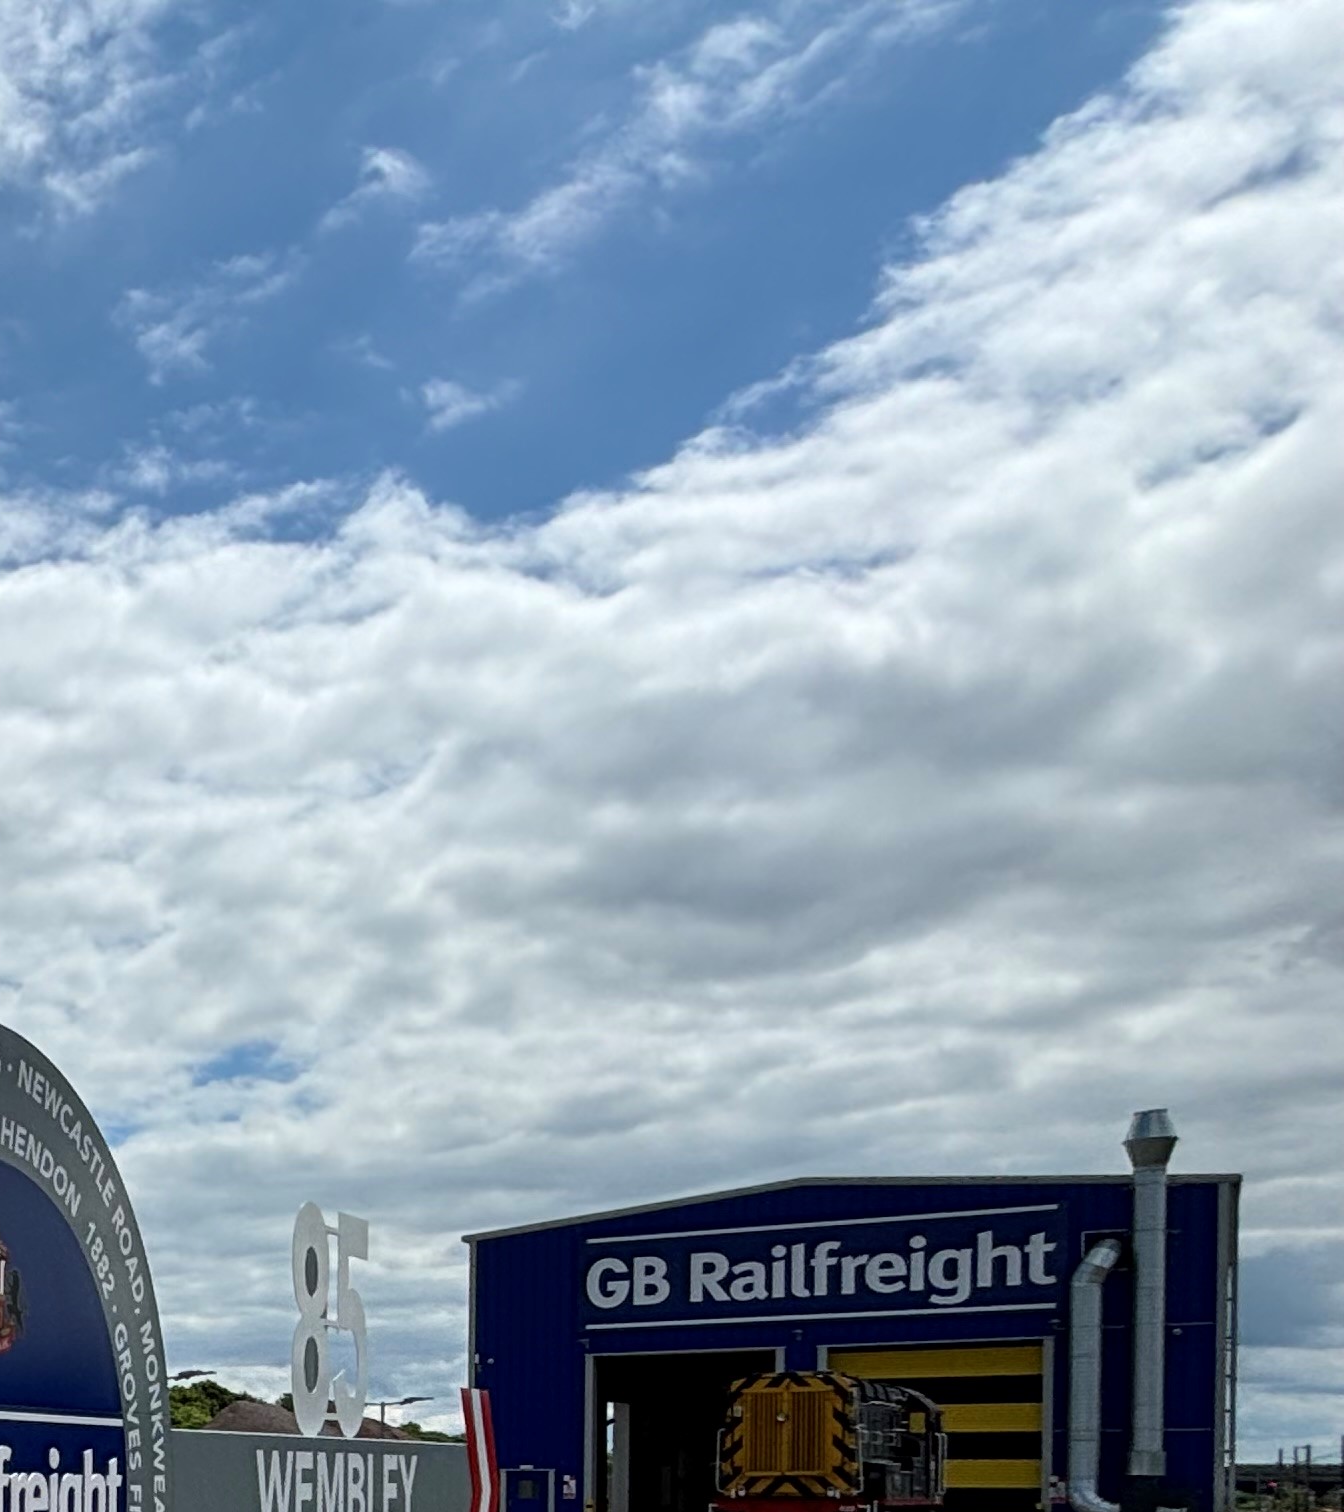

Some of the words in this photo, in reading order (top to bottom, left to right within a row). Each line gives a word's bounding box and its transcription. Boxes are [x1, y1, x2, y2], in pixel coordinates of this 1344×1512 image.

[17, 1059, 116, 1208] NEWCASTLE
[0, 1116, 82, 1218] HENDON
[85, 1221, 115, 1300] 1882
[114, 1322, 143, 1472] GROVES
[291, 1201, 369, 1438] 85
[585, 1255, 671, 1310] GB
[688, 1230, 1058, 1306] Railfreight
